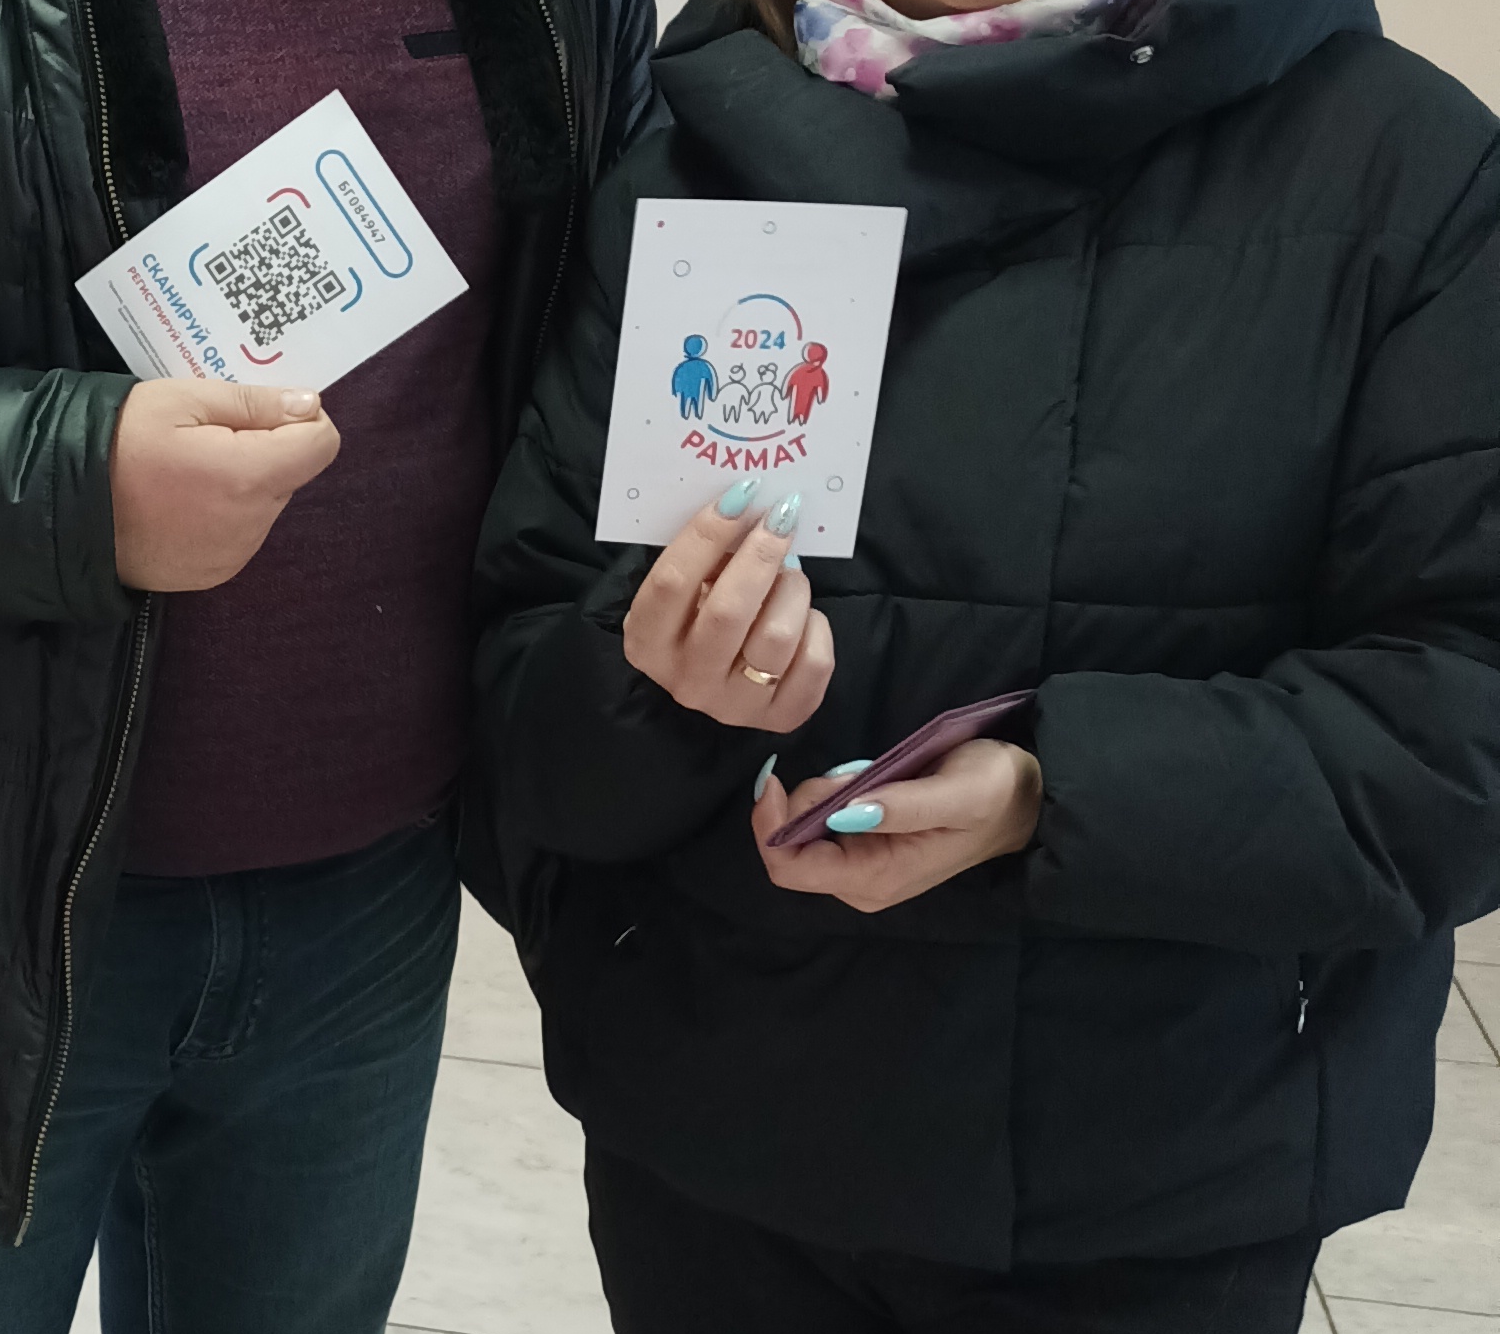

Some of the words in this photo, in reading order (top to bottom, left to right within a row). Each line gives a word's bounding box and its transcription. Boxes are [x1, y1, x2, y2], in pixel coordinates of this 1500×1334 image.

[337, 180, 386, 243] БГ084947
[127, 266, 182, 343] РЕГИСТРИРУЙ
[176, 341, 207, 380] НОМЕР
[142, 253, 211, 345] СКАНИРУЙ
[730, 329, 787, 350] 2024
[680, 429, 808, 472] РАХМАТ
